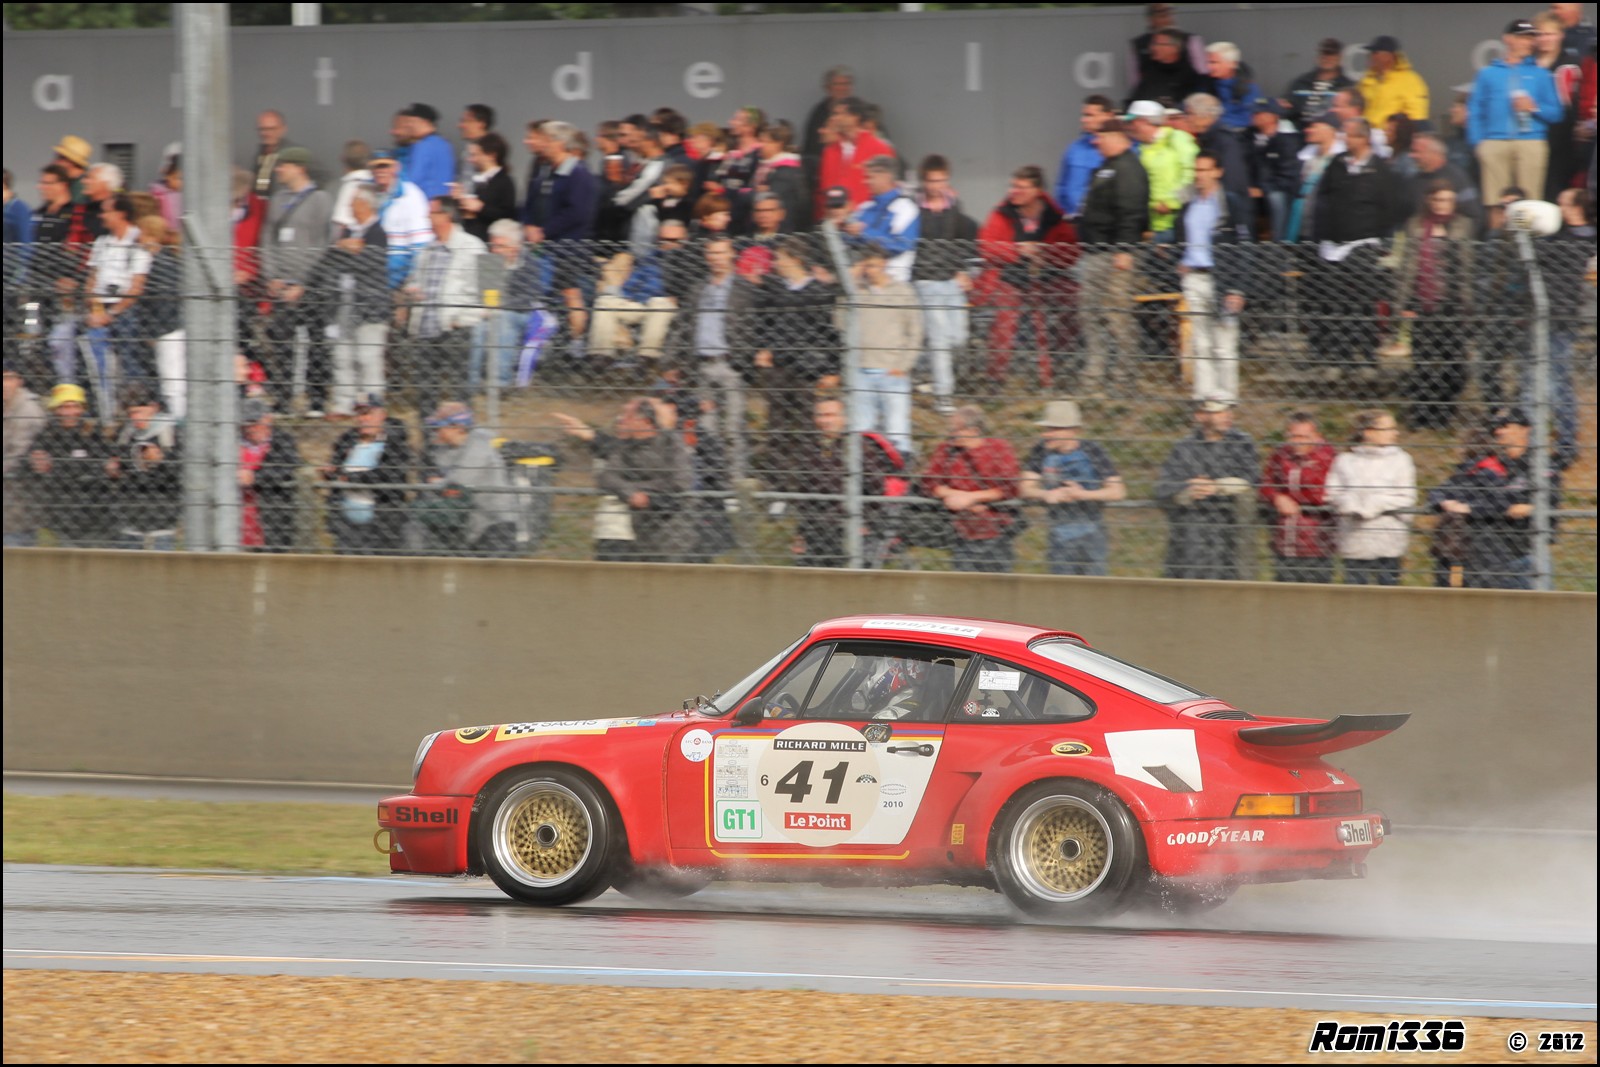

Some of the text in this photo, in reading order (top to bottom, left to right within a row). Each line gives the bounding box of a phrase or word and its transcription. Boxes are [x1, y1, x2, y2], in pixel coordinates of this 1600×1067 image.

[776, 740, 866, 751] RICHARD MILLE
[760, 774, 769, 786] 6
[774, 760, 850, 804] 41
[396, 806, 459, 824] Shell
[723, 808, 756, 830] GT1
[789, 815, 847, 828] Le Point
[1343, 822, 1371, 843] Shell
